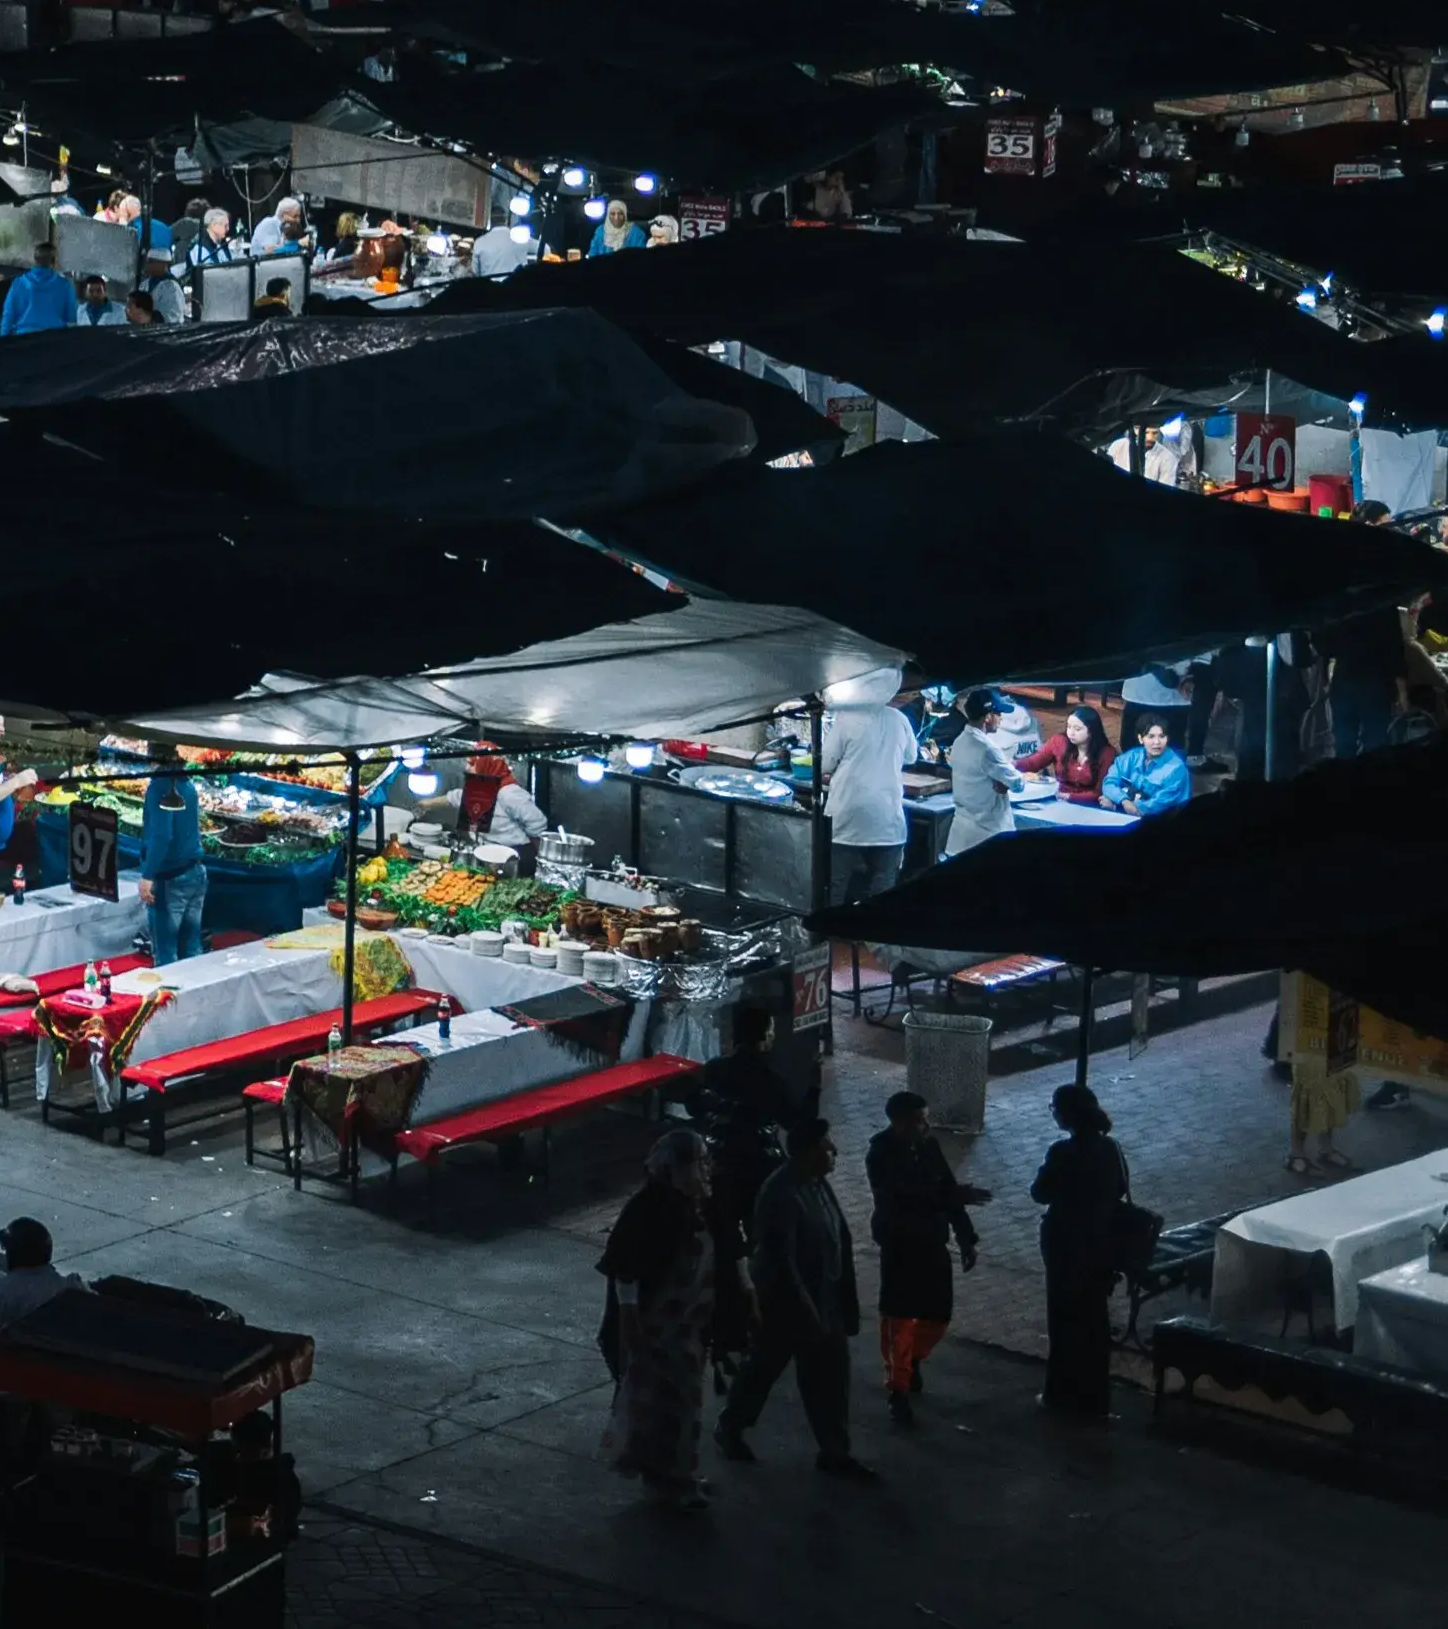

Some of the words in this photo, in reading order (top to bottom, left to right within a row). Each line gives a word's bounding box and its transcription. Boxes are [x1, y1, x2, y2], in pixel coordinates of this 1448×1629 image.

[989, 135, 1030, 156] 35
[1238, 435, 1293, 489] 40
[1017, 741, 1038, 755] NIKE
[72, 822, 114, 880] 97
[803, 967, 828, 1012] 76
